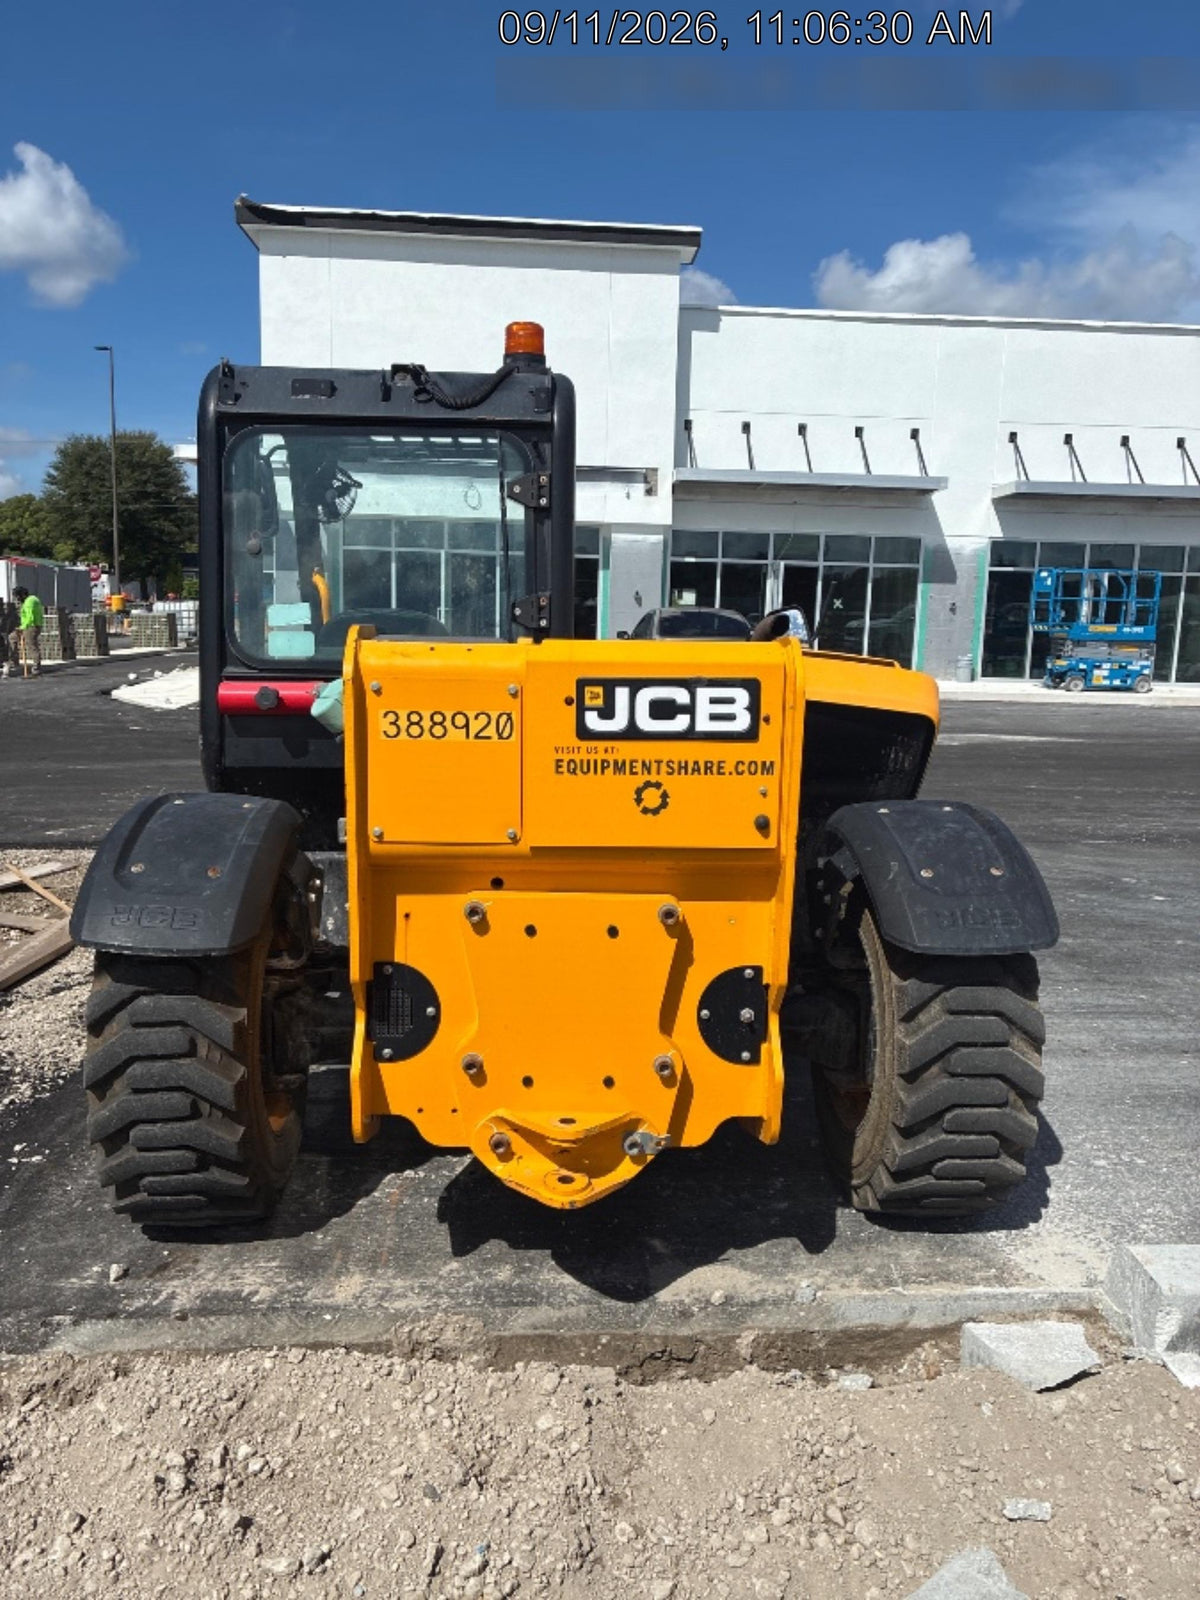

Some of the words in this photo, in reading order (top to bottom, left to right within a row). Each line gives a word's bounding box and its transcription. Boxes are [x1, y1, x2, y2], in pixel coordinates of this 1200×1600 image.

[584, 686, 752, 732] JCB
[383, 710, 514, 740] 388920
[553, 745, 583, 755] VISIT
[585, 745, 600, 755] US
[554, 758, 775, 776] EQUIPMENTSHARE.COM
